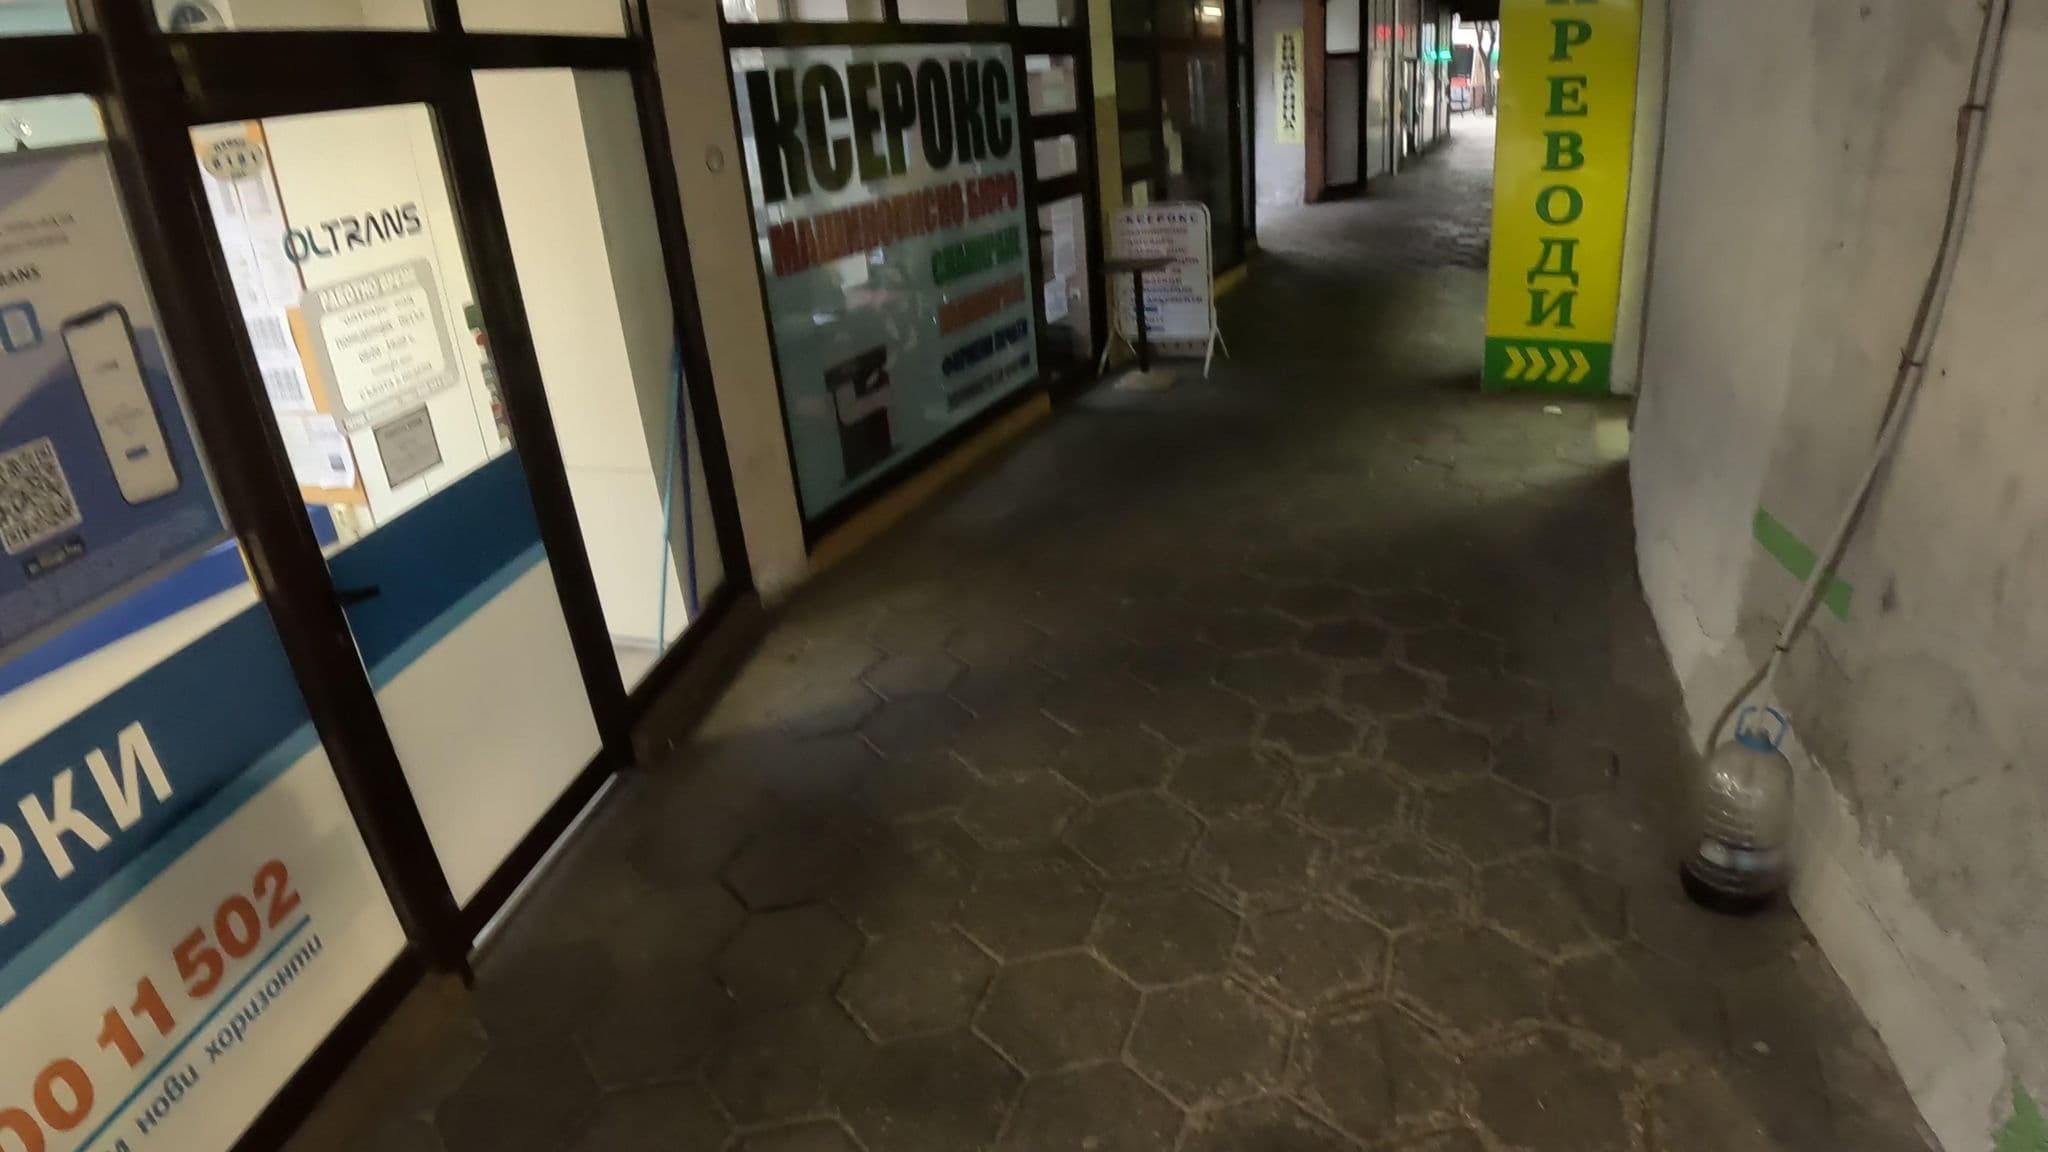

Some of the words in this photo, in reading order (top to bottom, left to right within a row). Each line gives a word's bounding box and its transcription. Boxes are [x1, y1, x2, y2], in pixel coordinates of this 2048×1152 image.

[746, 58, 1013, 203] КСЕРОКС
[1526, 0, 1593, 328] РЕВОДИ
[283, 201, 421, 264] OLTRANS
[97, 975, 176, 1069] 11
[173, 858, 302, 998] 502
[135, 1064, 199, 1135] нови
[206, 934, 322, 1062] хоризонти
